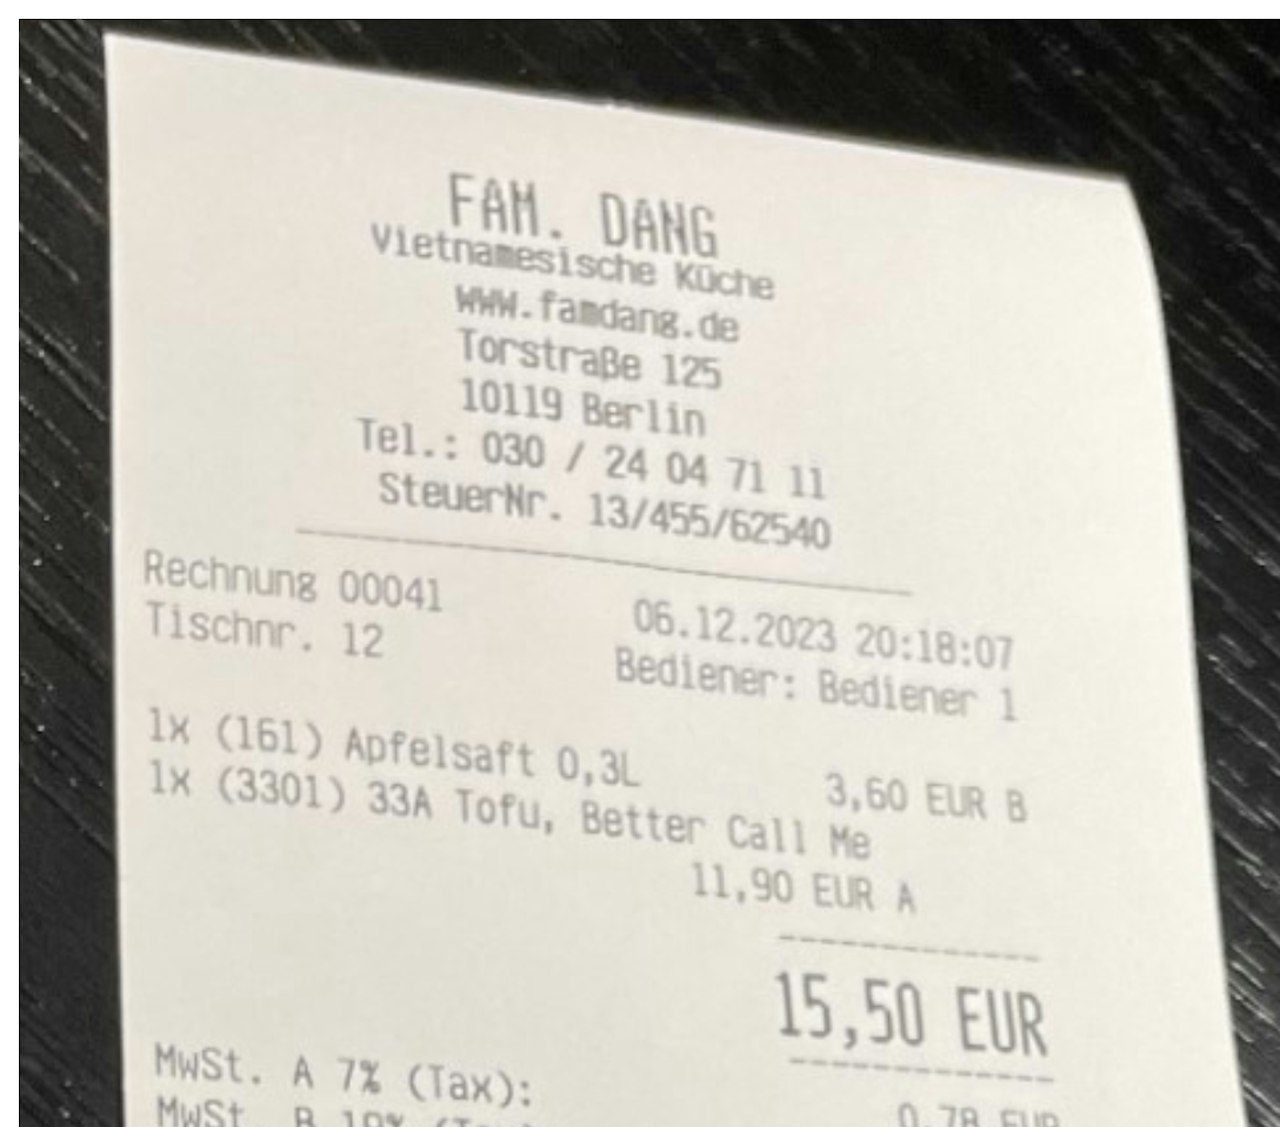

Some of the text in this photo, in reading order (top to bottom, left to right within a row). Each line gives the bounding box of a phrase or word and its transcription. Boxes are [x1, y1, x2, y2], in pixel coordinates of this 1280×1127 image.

[448, 170, 719, 259] FAM. DANG
[370, 221, 775, 302] Vietnamesische Küche
[458, 326, 723, 392] Torstraße 125
[461, 376, 707, 438] 10119 Berlin
[357, 416, 825, 502] Tel.: 030 / 24 04 71 11
[378, 470, 832, 552] SteuerNr. 13/455/62540
[143, 547, 1015, 671] Rechnung 00041 06.12.2023 20:18:07
[145, 598, 1018, 724] Tischnr. 12 Bediener: Bediener 1
[149, 705, 1029, 825] 1x (161) Apfelsaft 0,3L 3,60 EUR B
[150, 757, 871, 862] 1x (3301) 33A Tofu, Better Call Me
[691, 860, 917, 915] 11,90 EUR A
[775, 969, 1049, 1058] 15,50 EUR
[154, 1041, 261, 1087] MwSt.
[292, 1054, 315, 1090] A
[338, 1056, 382, 1097] 7%
[407, 1063, 532, 1110] (Tax):
